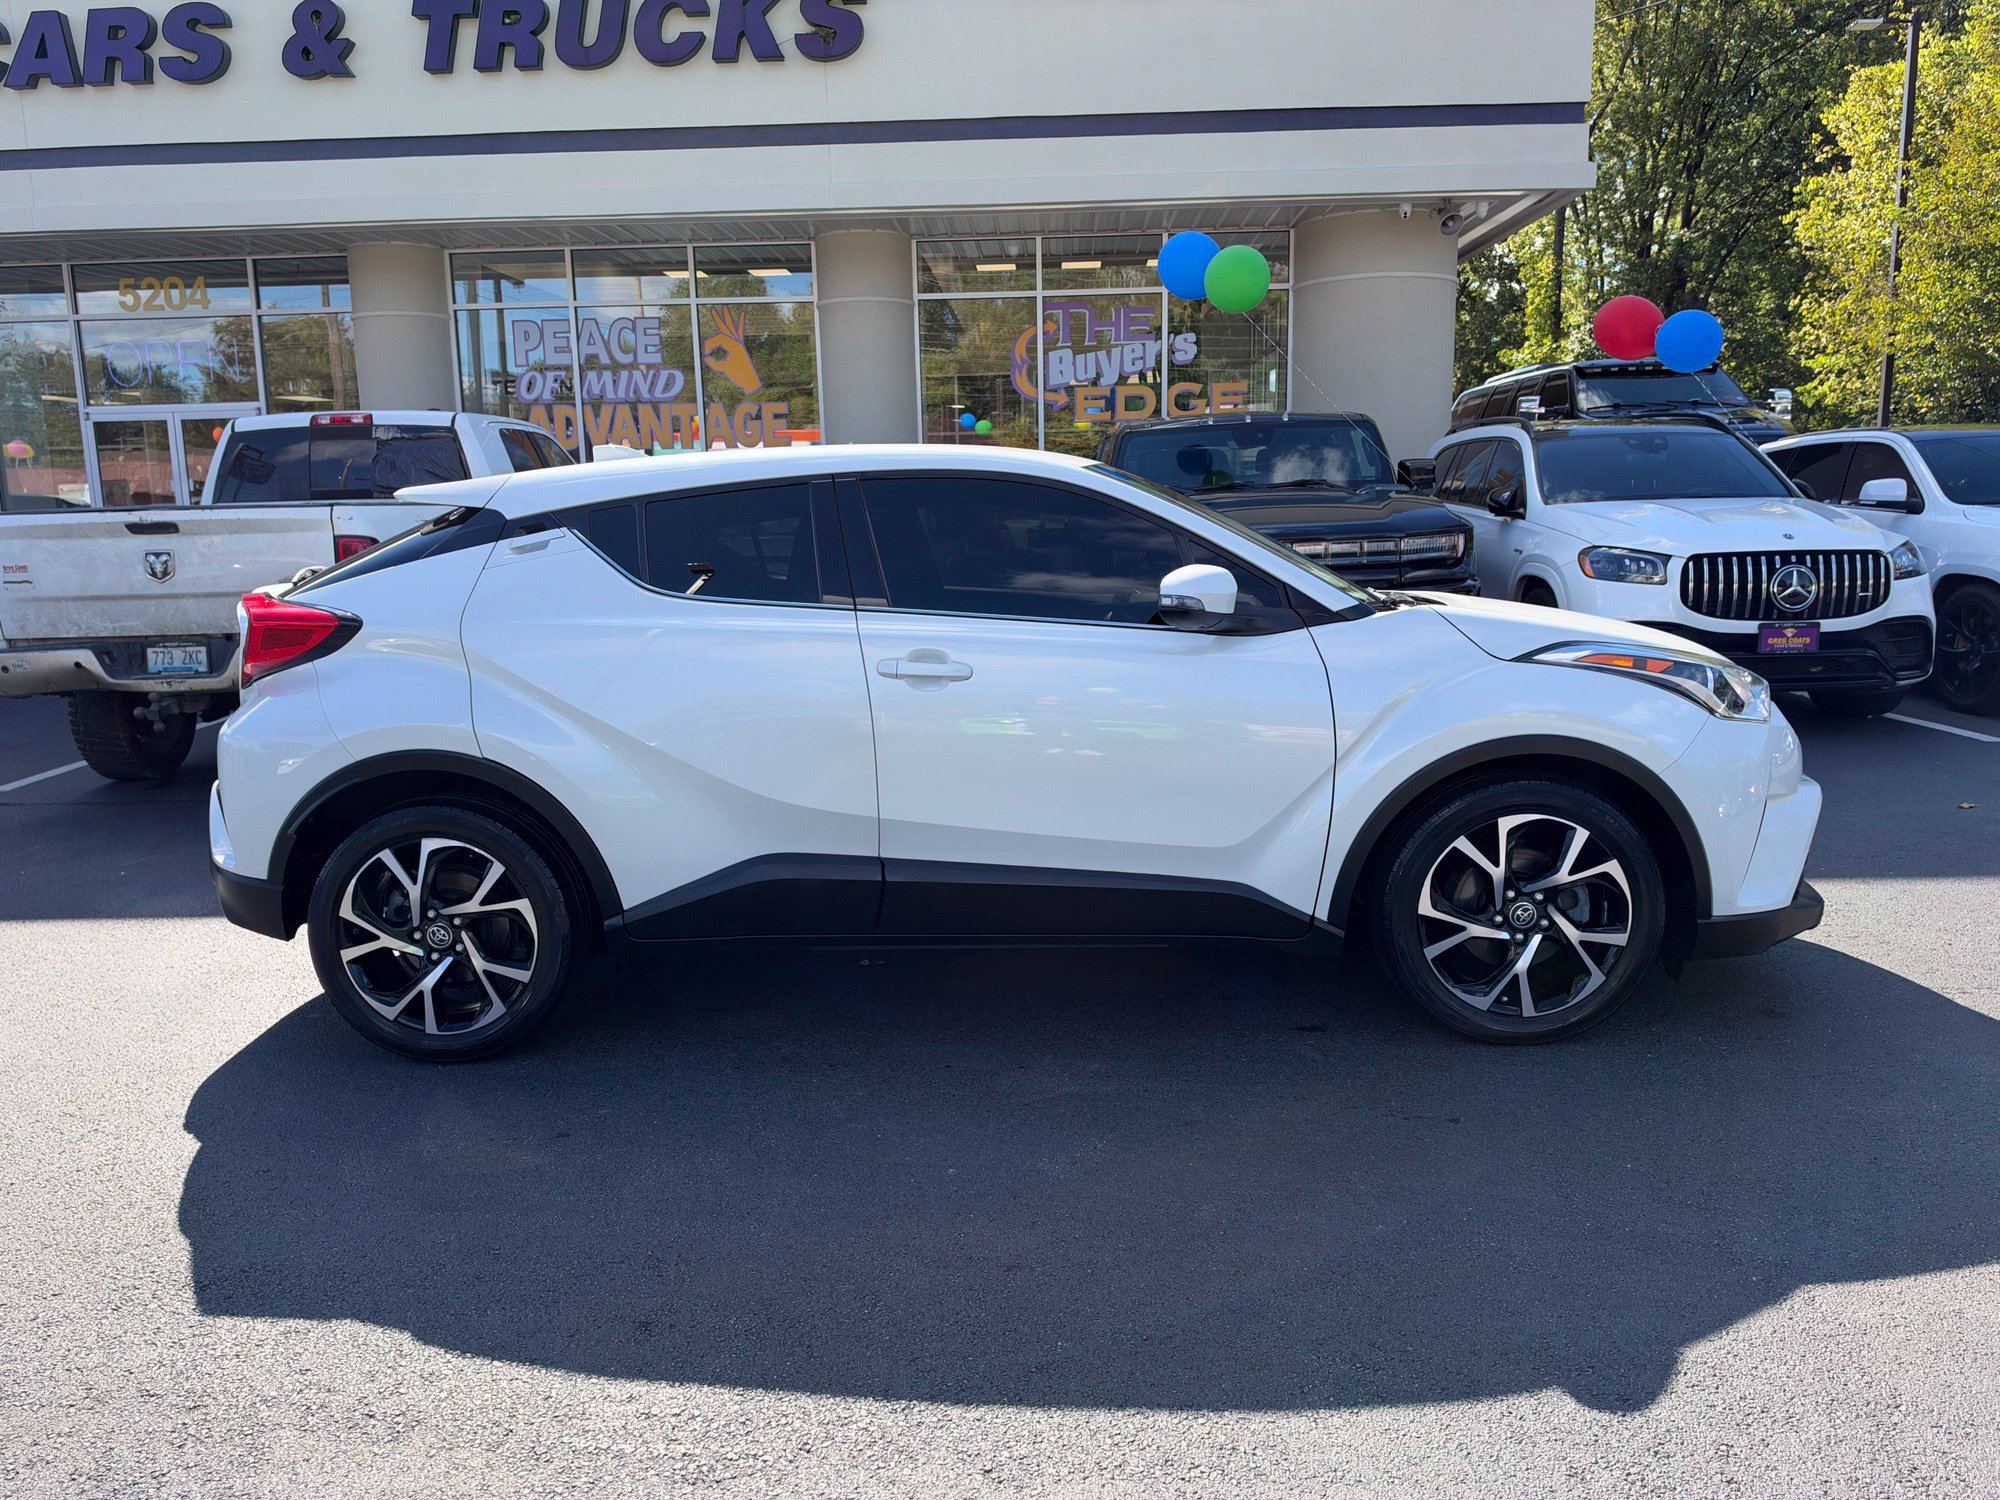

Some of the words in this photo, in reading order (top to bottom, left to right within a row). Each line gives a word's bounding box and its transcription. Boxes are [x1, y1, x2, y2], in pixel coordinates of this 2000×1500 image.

[0, 2, 233, 90] ARS
[282, 0, 356, 79] &
[411, 0, 867, 75] TRUCKS
[118, 275, 211, 312] 5204
[512, 317, 663, 367] PEACE
[1044, 301, 1156, 347] THE
[107, 338, 240, 387] OPEN
[1046, 331, 1198, 389] Buyer's
[516, 369, 566, 403] OF
[580, 367, 684, 401] MIND
[1073, 382, 1250, 422] EDGE
[527, 401, 793, 451] ADVANTAGE
[152, 650, 174, 666] 773
[182, 649, 202, 665] ZKC
